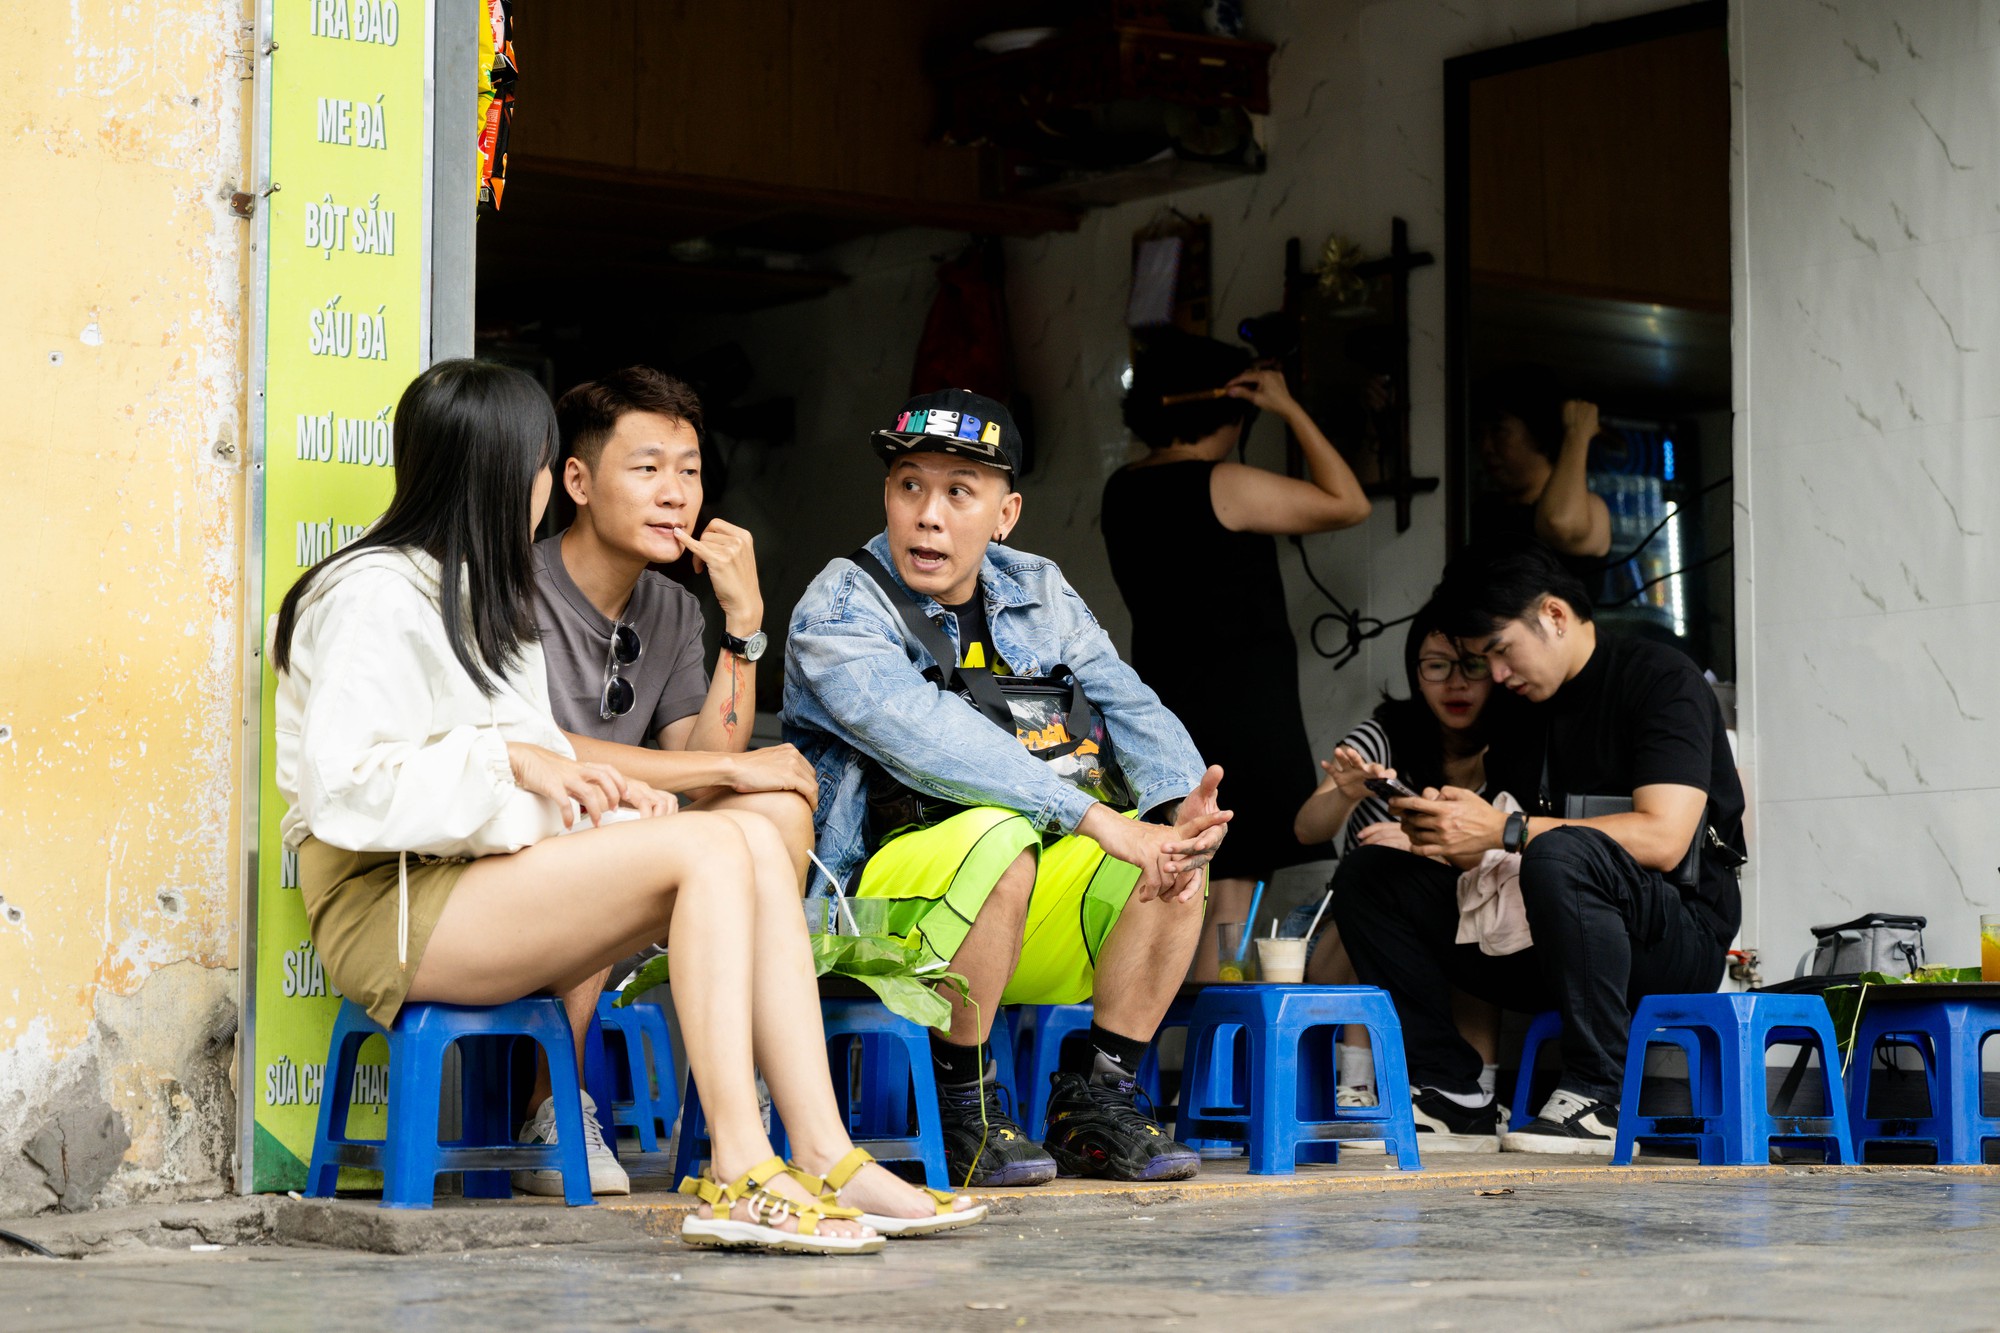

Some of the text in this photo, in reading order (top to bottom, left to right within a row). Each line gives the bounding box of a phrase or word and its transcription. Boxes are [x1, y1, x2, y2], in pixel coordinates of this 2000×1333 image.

[317, 93, 387, 150] ME ĐÁ
[304, 193, 395, 260] BỘT SẮN
[308, 294, 387, 361] SẤU ĐÁ
[296, 411, 334, 463] MƠ
[295, 517, 334, 567] MƠ
[282, 940, 326, 998] SỮA
[265, 1056, 299, 1106] SỮA
[351, 1063, 389, 1115] THẠC
